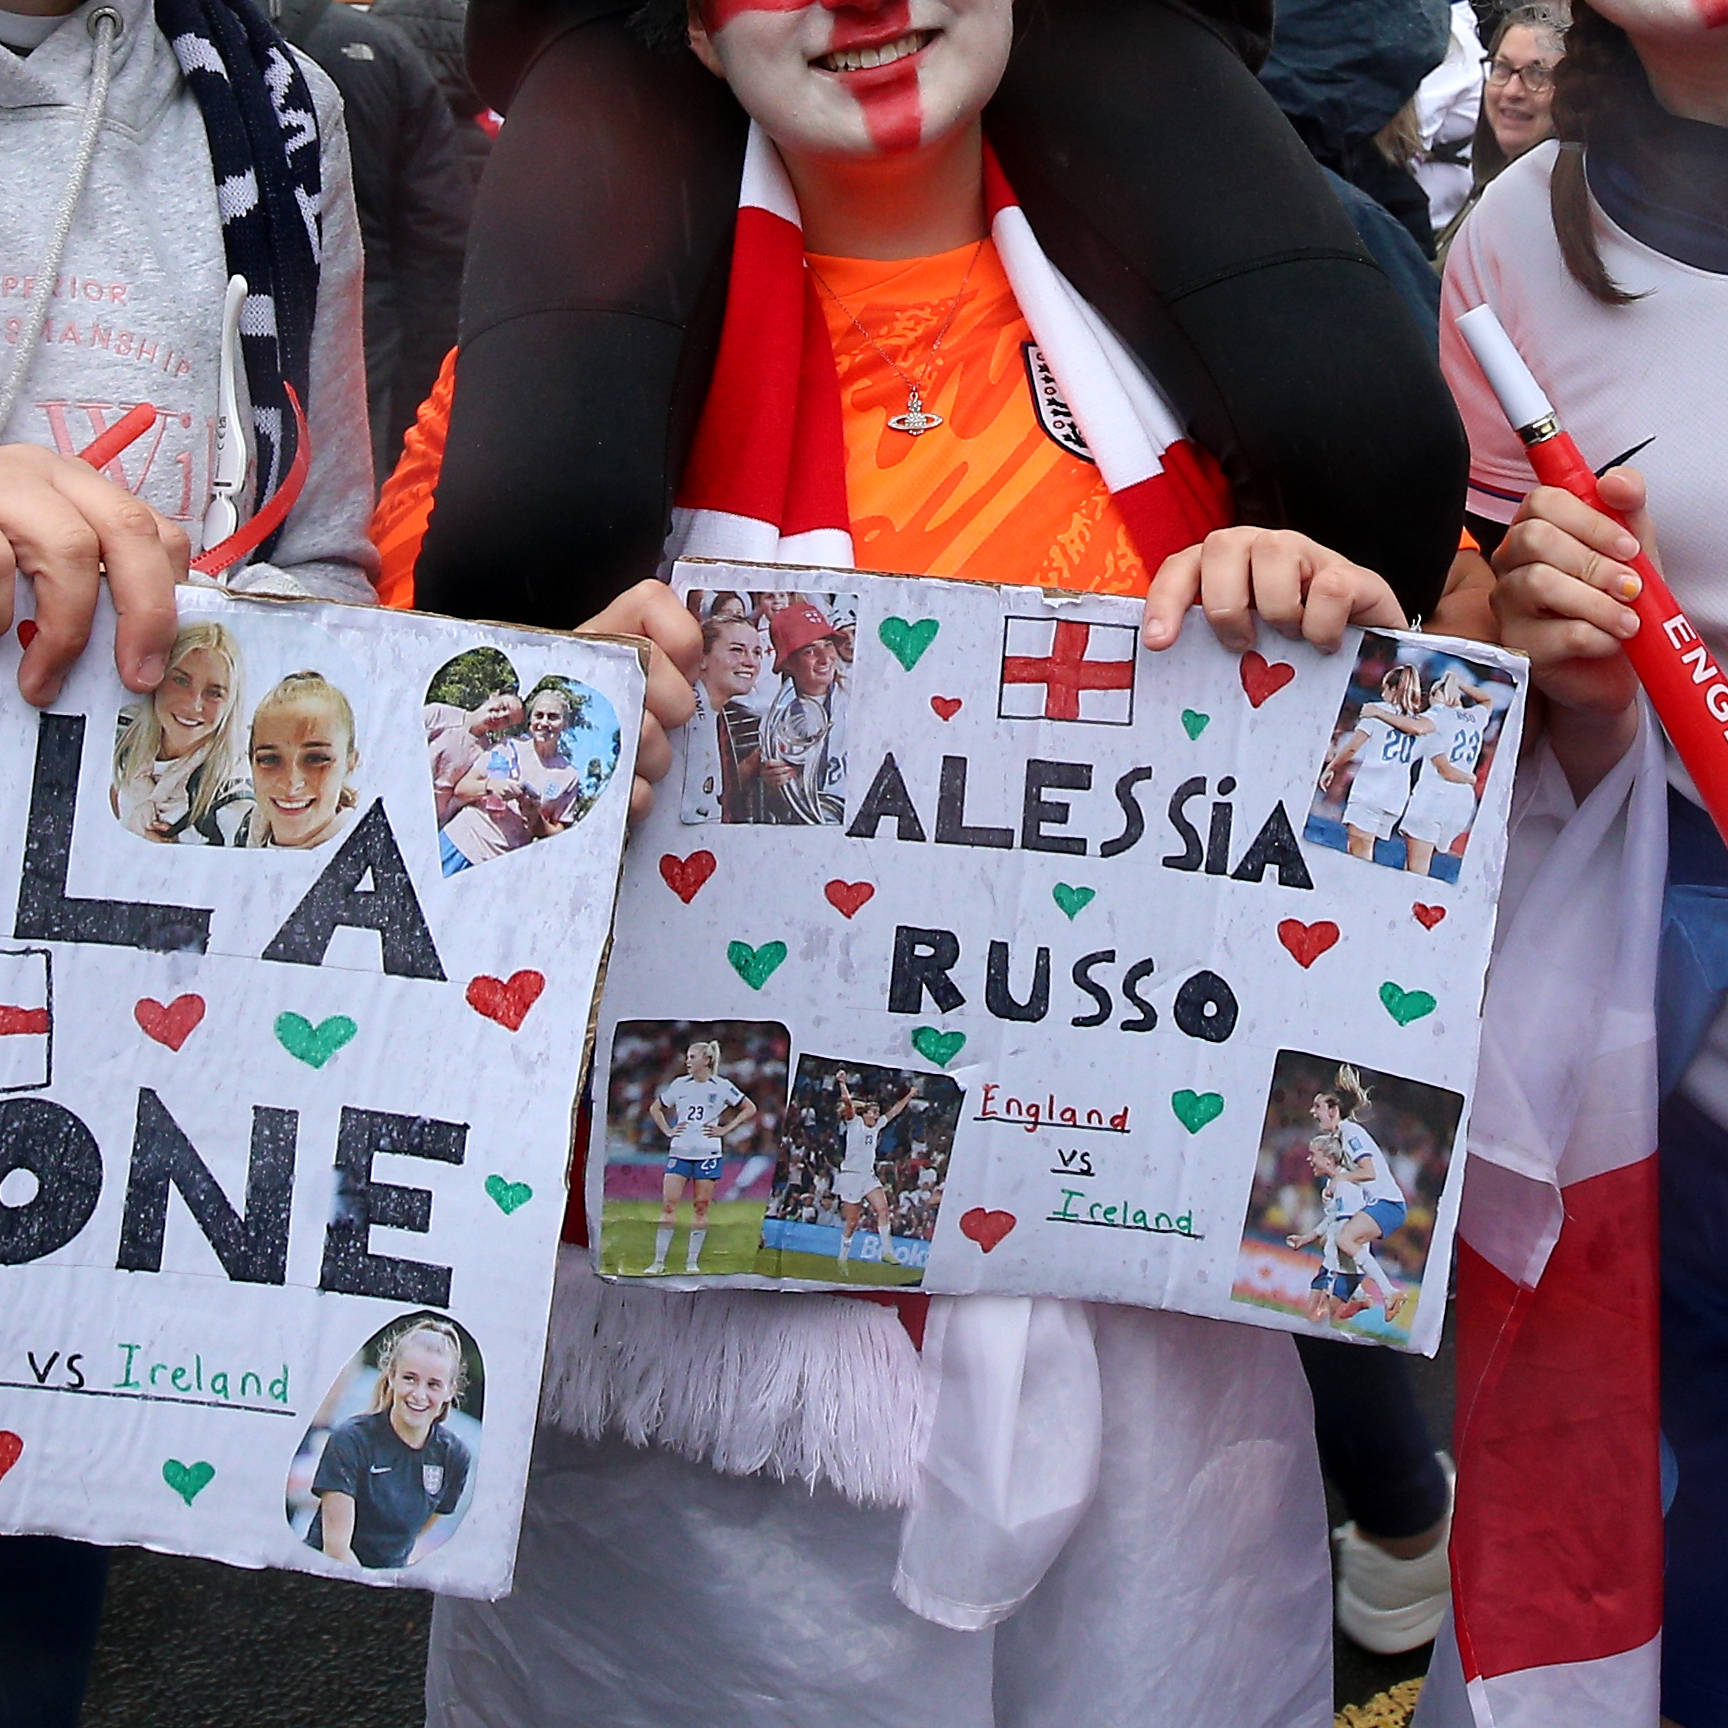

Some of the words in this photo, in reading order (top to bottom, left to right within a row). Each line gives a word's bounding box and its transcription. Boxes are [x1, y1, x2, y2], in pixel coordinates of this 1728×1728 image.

[1382, 728, 1417, 764] 20
[887, 924, 1240, 1045] RUSSO
[687, 1105, 705, 1121] 23
[980, 1083, 1131, 1134] England
[1052, 1188, 1194, 1235] Ireland
[112, 1342, 289, 1405] Ireland
